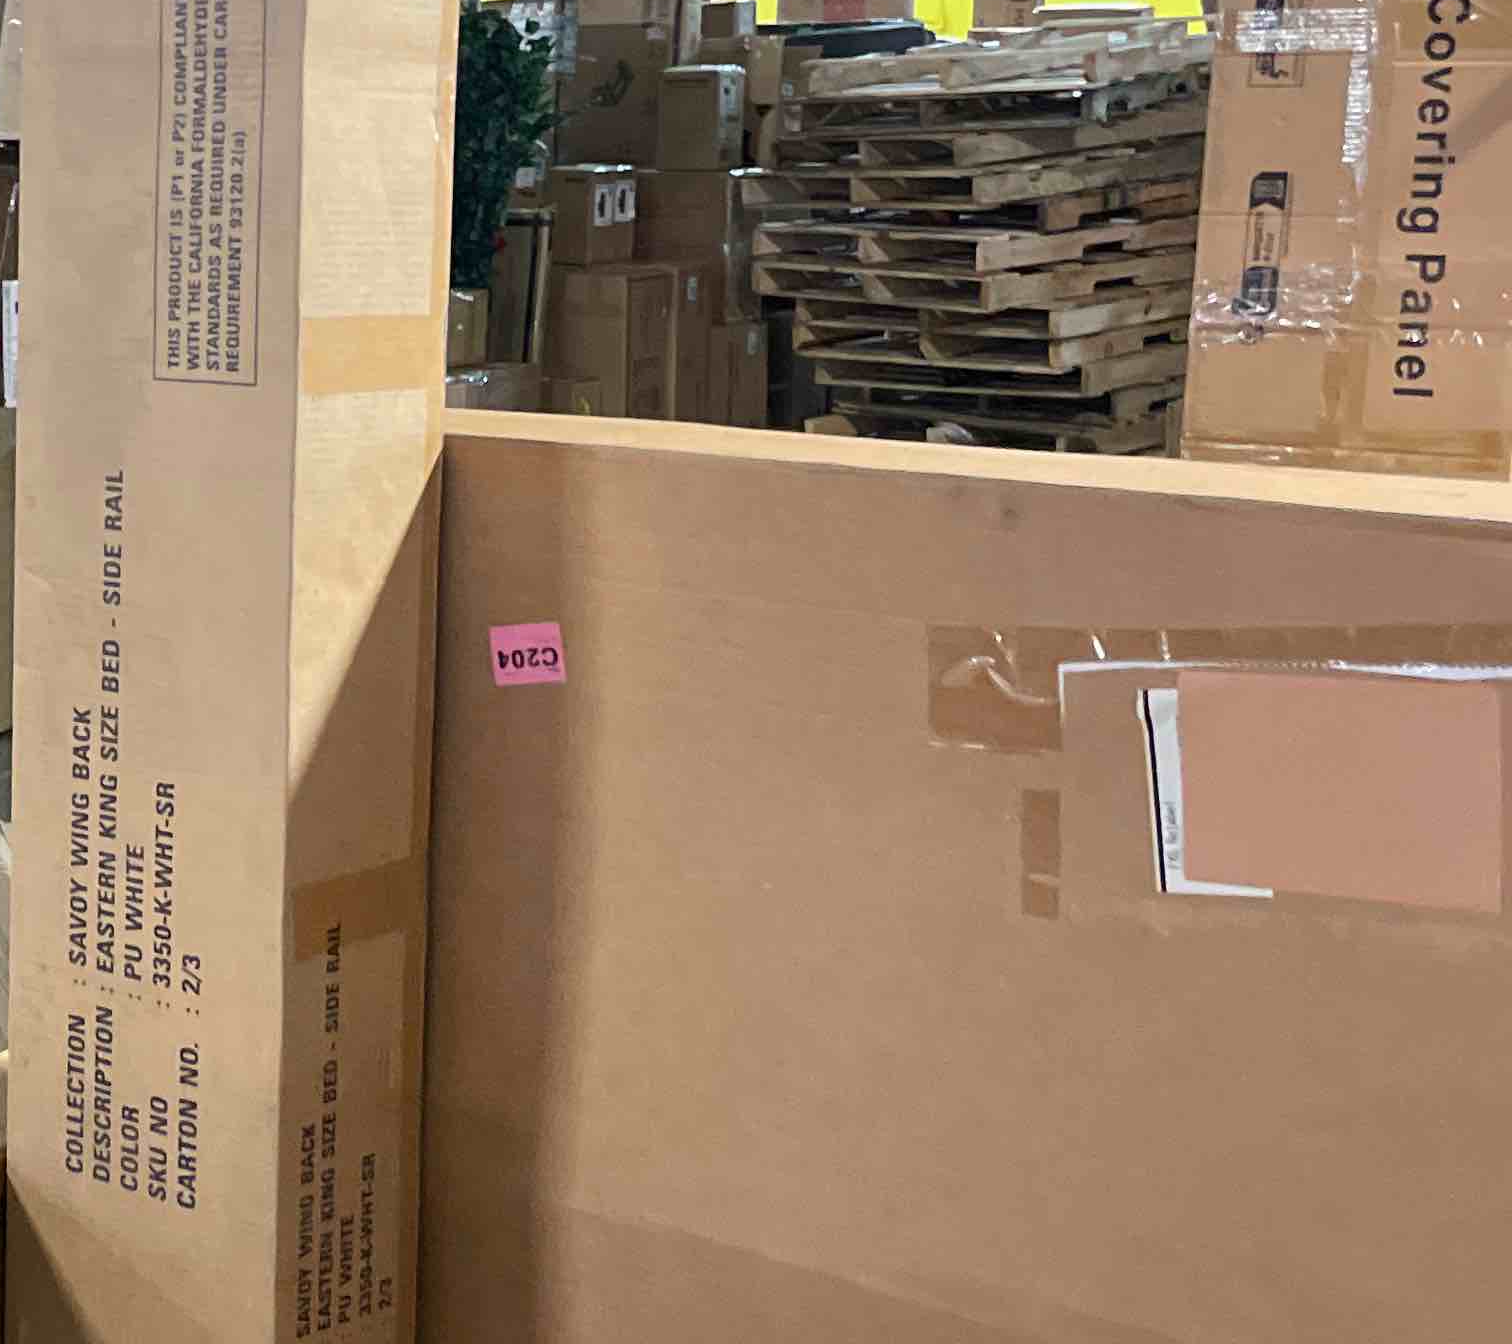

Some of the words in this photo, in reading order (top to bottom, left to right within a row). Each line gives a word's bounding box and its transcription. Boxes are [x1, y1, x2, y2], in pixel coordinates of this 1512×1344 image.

[212, 47, 227, 114] UNDER
[175, 150, 186, 168] or
[209, 120, 226, 217] REQUIRED
[228, 131, 248, 230] 93120.2(a)
[169, 208, 184, 228] IS
[188, 159, 205, 274] CALIFORNIA
[208, 222, 223, 249] AS
[168, 233, 183, 322] PRODUCT
[187, 279, 201, 314] THE
[225, 236, 242, 373] REQUIREMENT
[186, 320, 201, 371] WITH
[205, 256, 223, 371] STANDARDS
[1392, 254, 1447, 398] Panel
[167, 327, 181, 369] THIS
[103, 468, 124, 532] RAIL
[102, 543, 122, 607] SIDE
[101, 639, 120, 694] BED
[496, 647, 559, 669] C204
[71, 706, 91, 781] BACK
[100, 704, 119, 763] SIZE
[70, 792, 90, 867] WING
[98, 773, 118, 841] KING
[95, 851, 117, 974] EASTERN
[125, 843, 146, 933] WHITE
[152, 781, 176, 990] 3350-K-WHT-SR
[68, 878, 88, 968] SAVOY
[326, 922, 342, 974] RAIL
[124, 943, 143, 984] PU
[182, 954, 202, 996] 2/3
[325, 982, 340, 1034] SIDE
[65, 1013, 86, 1174] COLLECTION
[92, 1006, 115, 1185] DESCRIPTION
[179, 1042, 200, 1089] NO.
[323, 1059, 338, 1104] BED
[119, 1104, 141, 1193] COLOR
[150, 1095, 169, 1140] NO
[321, 1111, 337, 1160] SIZE
[148, 1147, 168, 1203] SKU
[176, 1099, 198, 1210] CARTON
[300, 1122, 316, 1185] BACK
[319, 1167, 336, 1222] KING
[297, 1194, 315, 1262] WING
[339, 1214, 355, 1288] WHITE
[296, 1268, 313, 1339] SAVOY
[316, 1230, 334, 1332] EASTERN
[338, 1293, 352, 1324] PU
